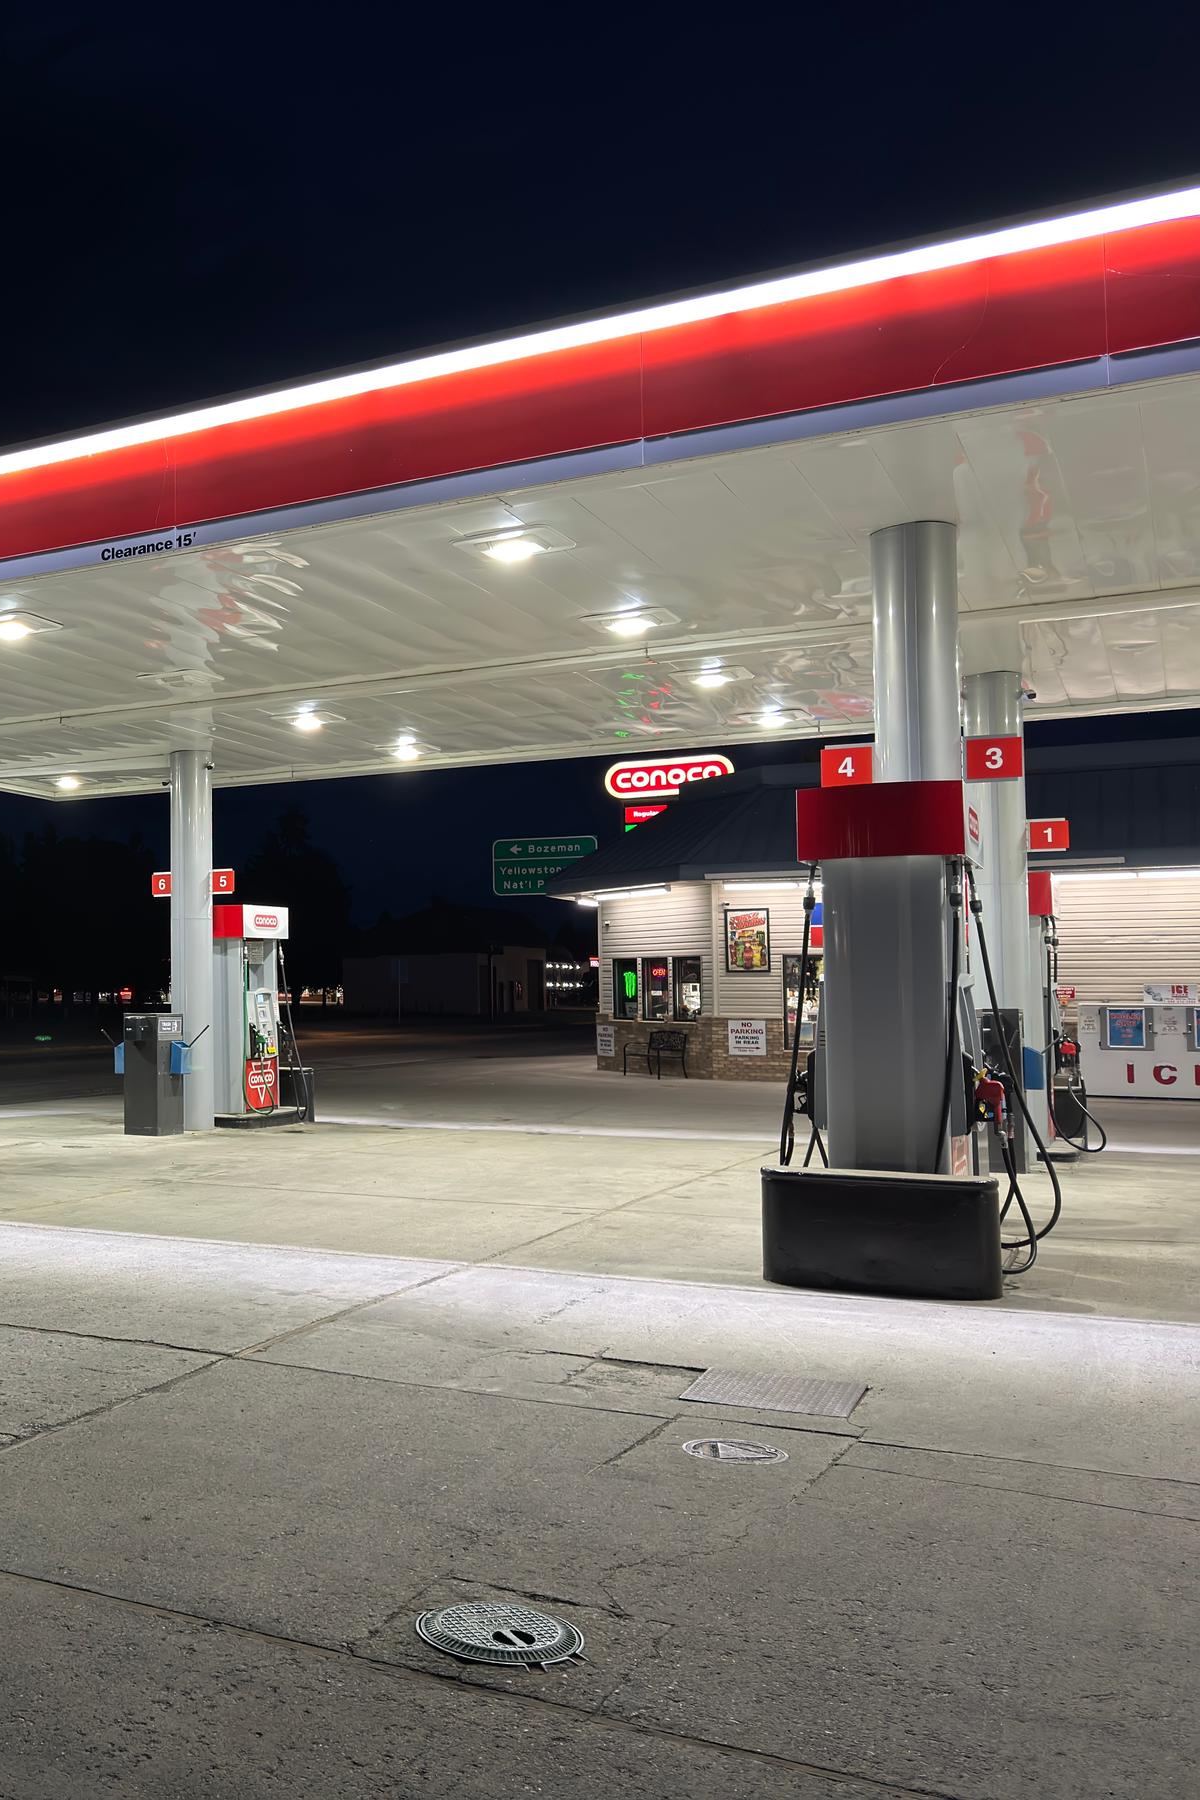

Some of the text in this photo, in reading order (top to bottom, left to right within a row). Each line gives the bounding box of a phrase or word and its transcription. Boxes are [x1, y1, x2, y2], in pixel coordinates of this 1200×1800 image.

[101, 540, 173, 560] Clearance
[985, 747, 1004, 769] 3
[837, 756, 855, 777] 4
[1043, 827, 1053, 843] 1
[528, 844, 580, 853] Bozeman
[500, 866, 562, 875] Yellowston
[158, 878, 166, 890] 6
[219, 875, 227, 887] 5
[652, 967, 666, 977] OPEN
[1171, 985, 1189, 994] ICE
[1127, 1063, 1200, 1086] IC
